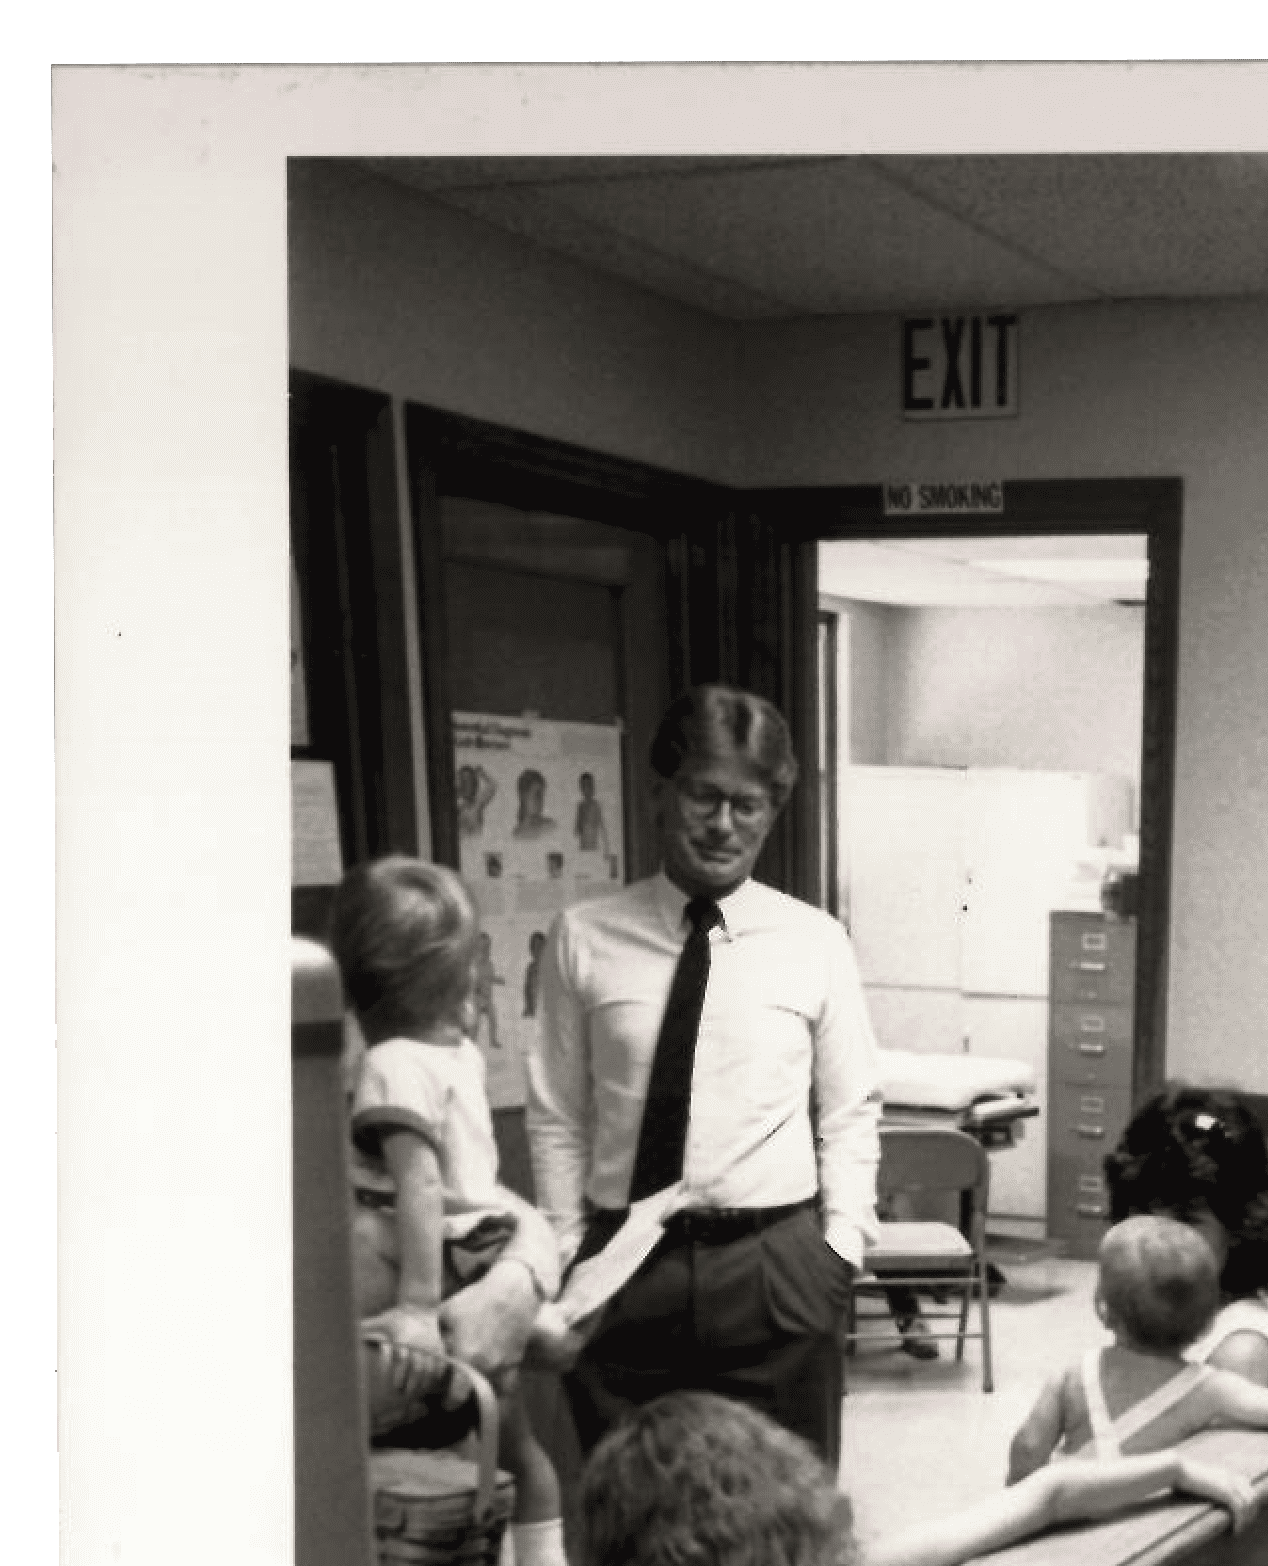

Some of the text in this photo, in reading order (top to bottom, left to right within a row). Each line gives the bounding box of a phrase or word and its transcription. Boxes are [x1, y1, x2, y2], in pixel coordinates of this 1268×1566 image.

[903, 315, 1018, 410] EXIT
[887, 482, 1002, 510] NO SMOKING
